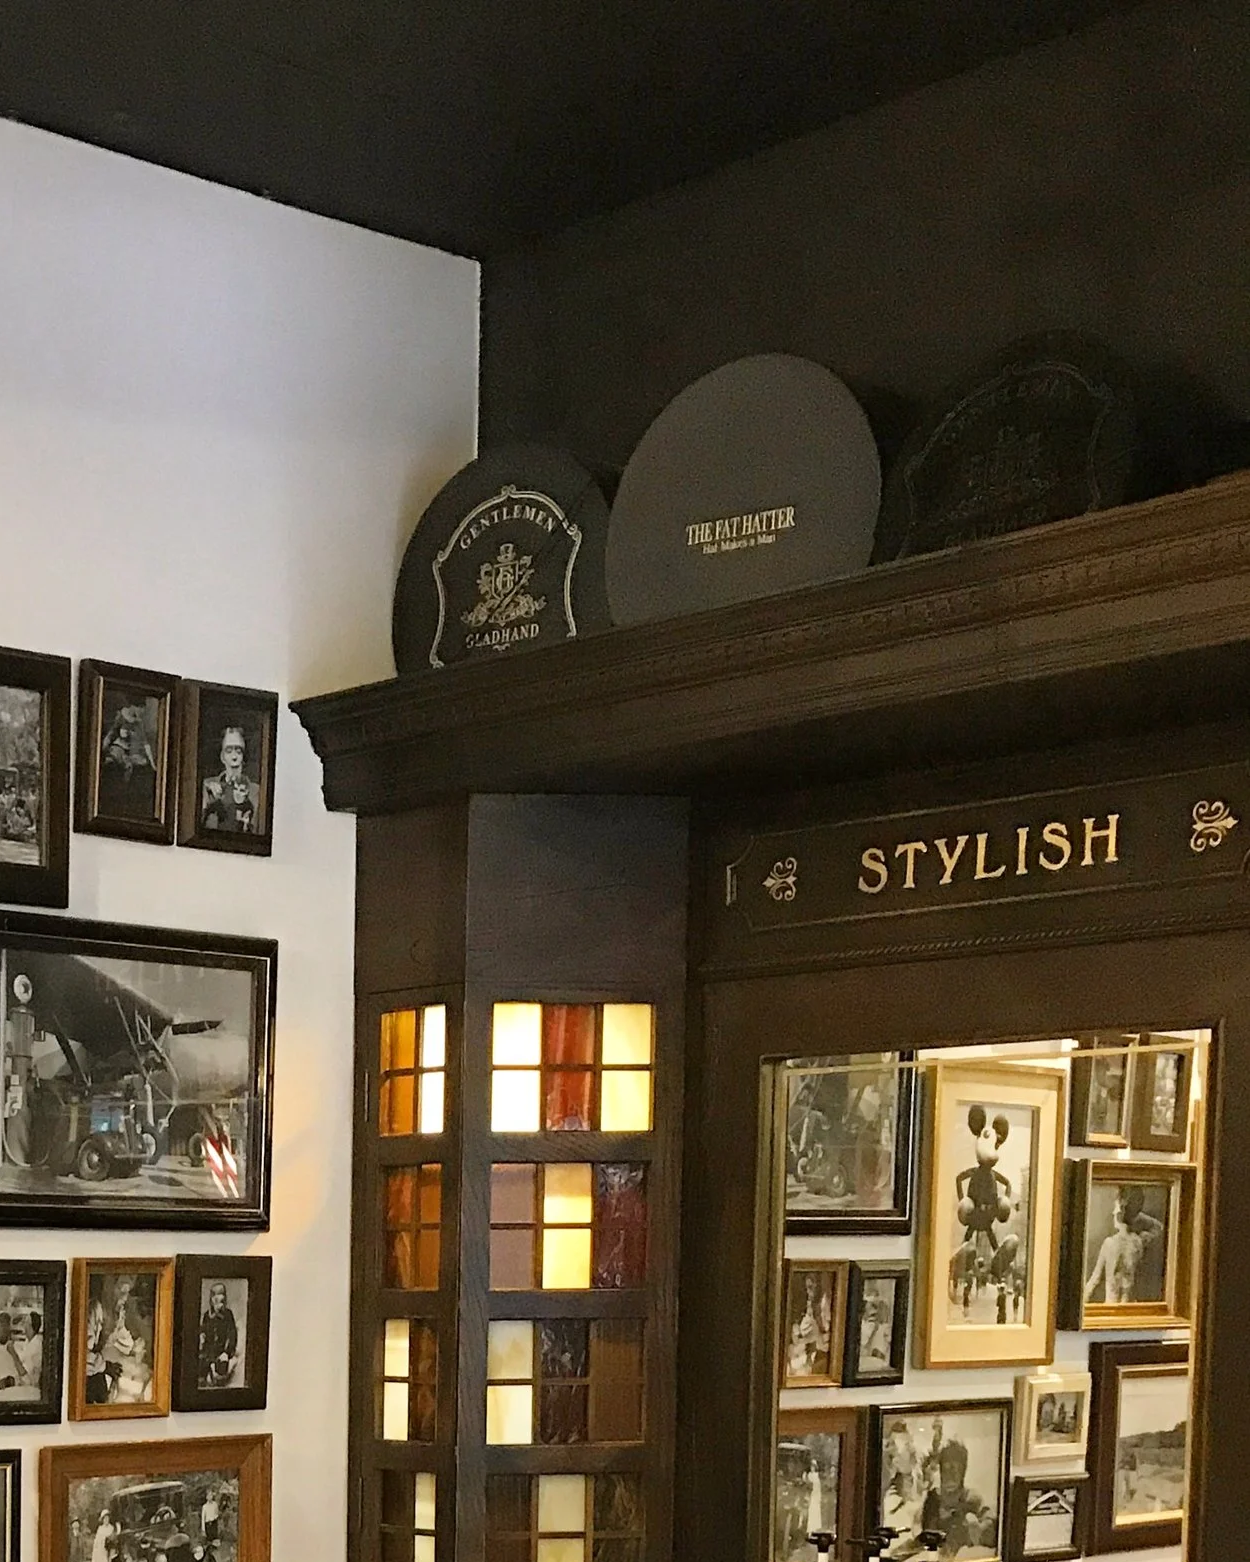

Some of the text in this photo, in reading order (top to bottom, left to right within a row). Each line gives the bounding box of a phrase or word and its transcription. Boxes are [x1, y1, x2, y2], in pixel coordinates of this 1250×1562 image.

[459, 505, 557, 549] GENTLEMEN
[686, 506, 796, 545] THE FAT HATTER
[466, 623, 539, 648] GLADHAND
[858, 813, 1121, 894] STYLISH
